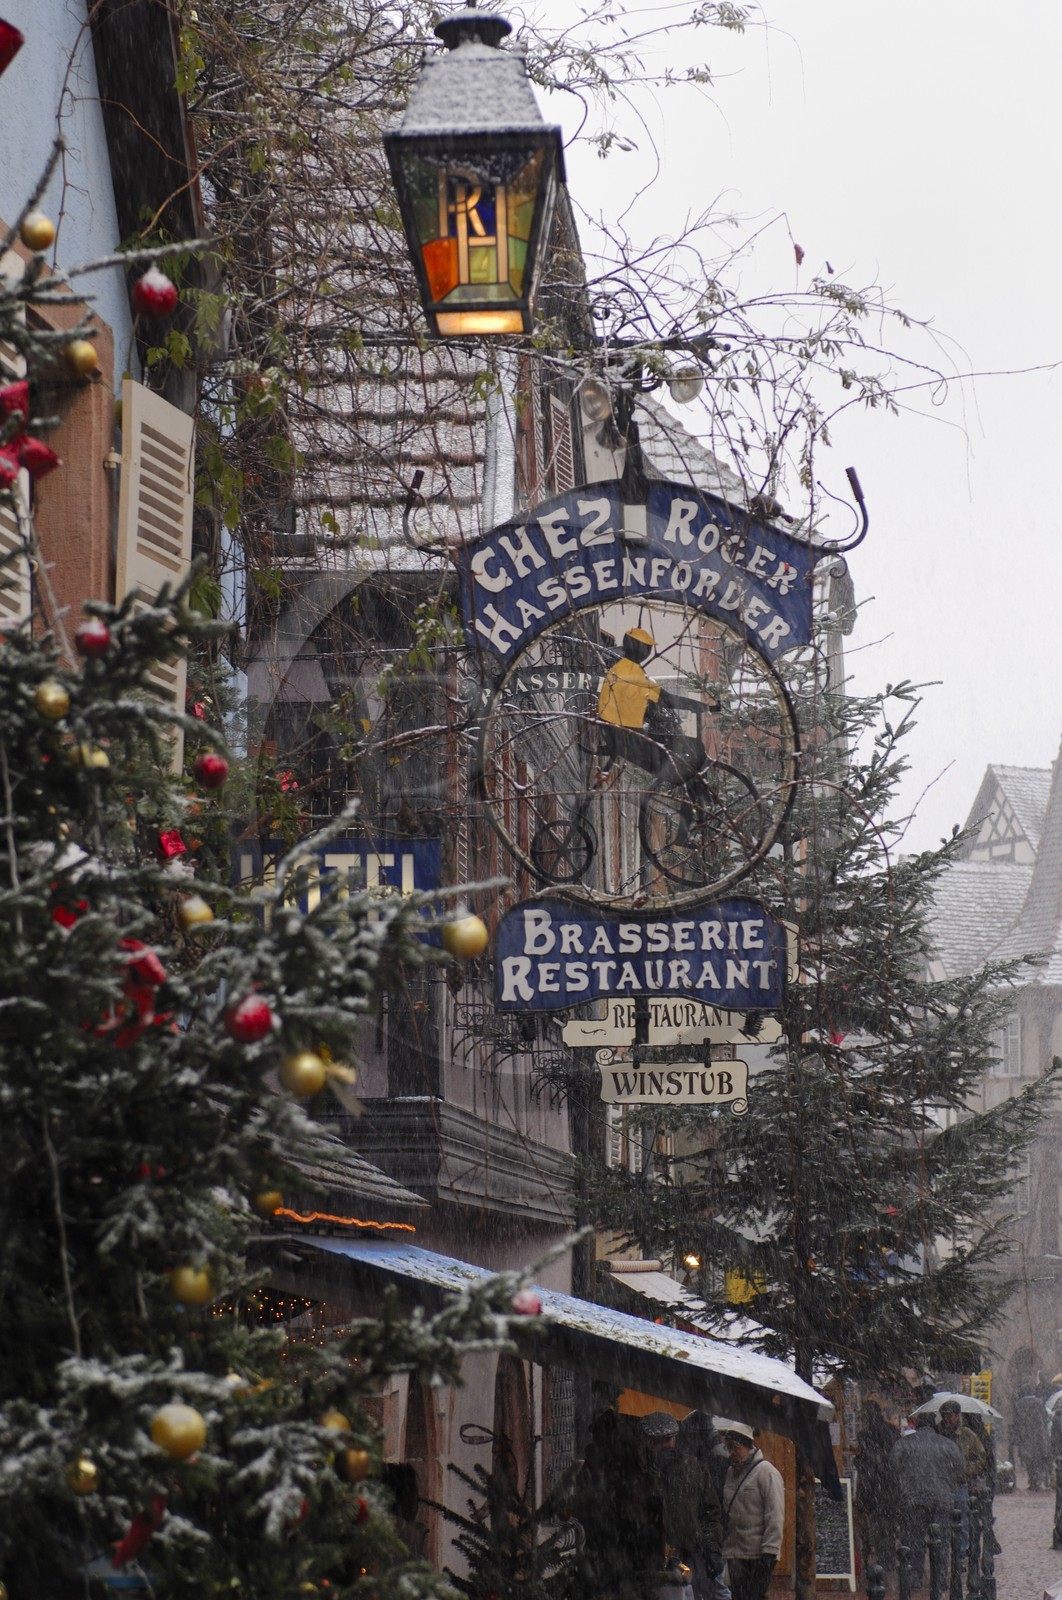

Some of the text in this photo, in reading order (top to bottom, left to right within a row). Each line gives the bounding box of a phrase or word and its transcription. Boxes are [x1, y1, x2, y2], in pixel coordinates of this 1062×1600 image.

[471, 498, 797, 595] CHEZ ROGER
[475, 557, 790, 653] HASSENFORDER
[524, 909, 764, 955] BRASSERIE
[501, 957, 777, 1001] RESTAURANT
[613, 1003, 733, 1028] RETAURANT
[611, 1070, 734, 1096] WINSTUB
